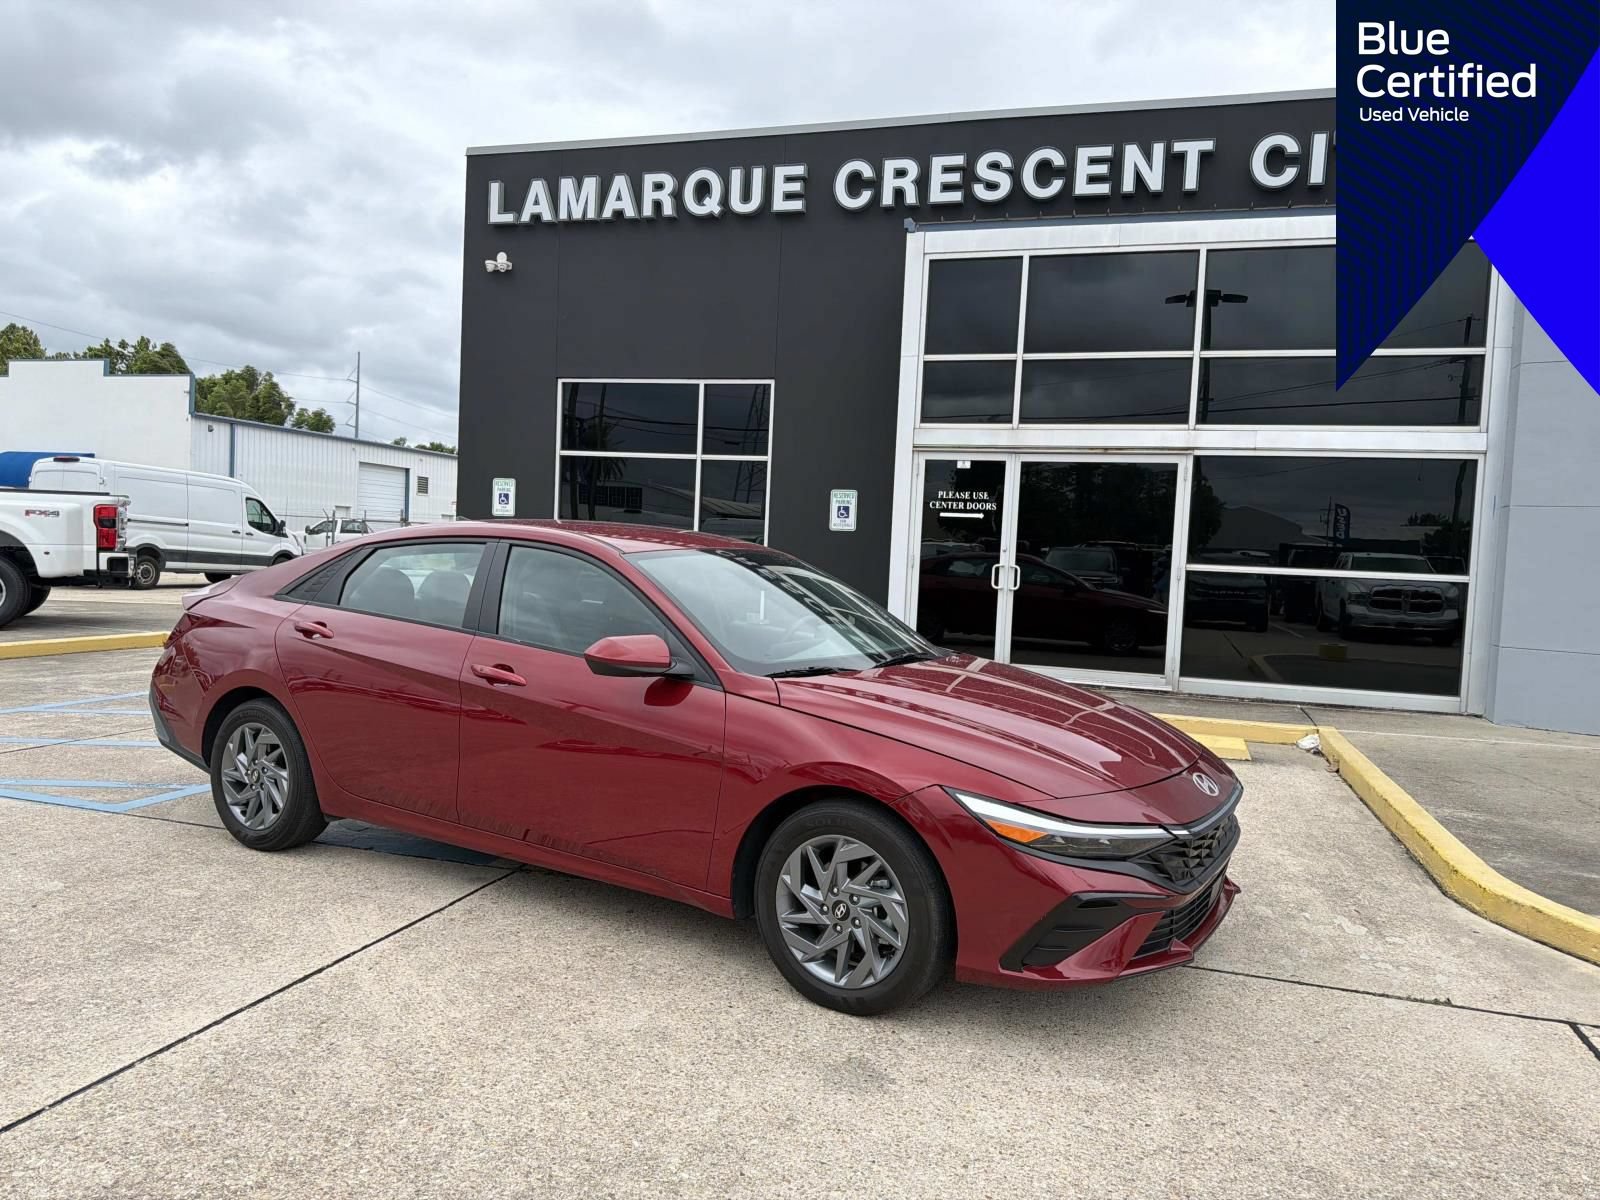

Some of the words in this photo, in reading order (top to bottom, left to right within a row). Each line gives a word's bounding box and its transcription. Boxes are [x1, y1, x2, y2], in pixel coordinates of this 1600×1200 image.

[488, 163, 807, 224] LAMARQUE
[833, 137, 1216, 211] CRESCENT
[1249, 130, 1336, 190] CI
[938, 490, 971, 499] PLEASE
[973, 491, 989, 499] USE
[929, 501, 964, 510] CENTER
[966, 502, 997, 511] DOORS
